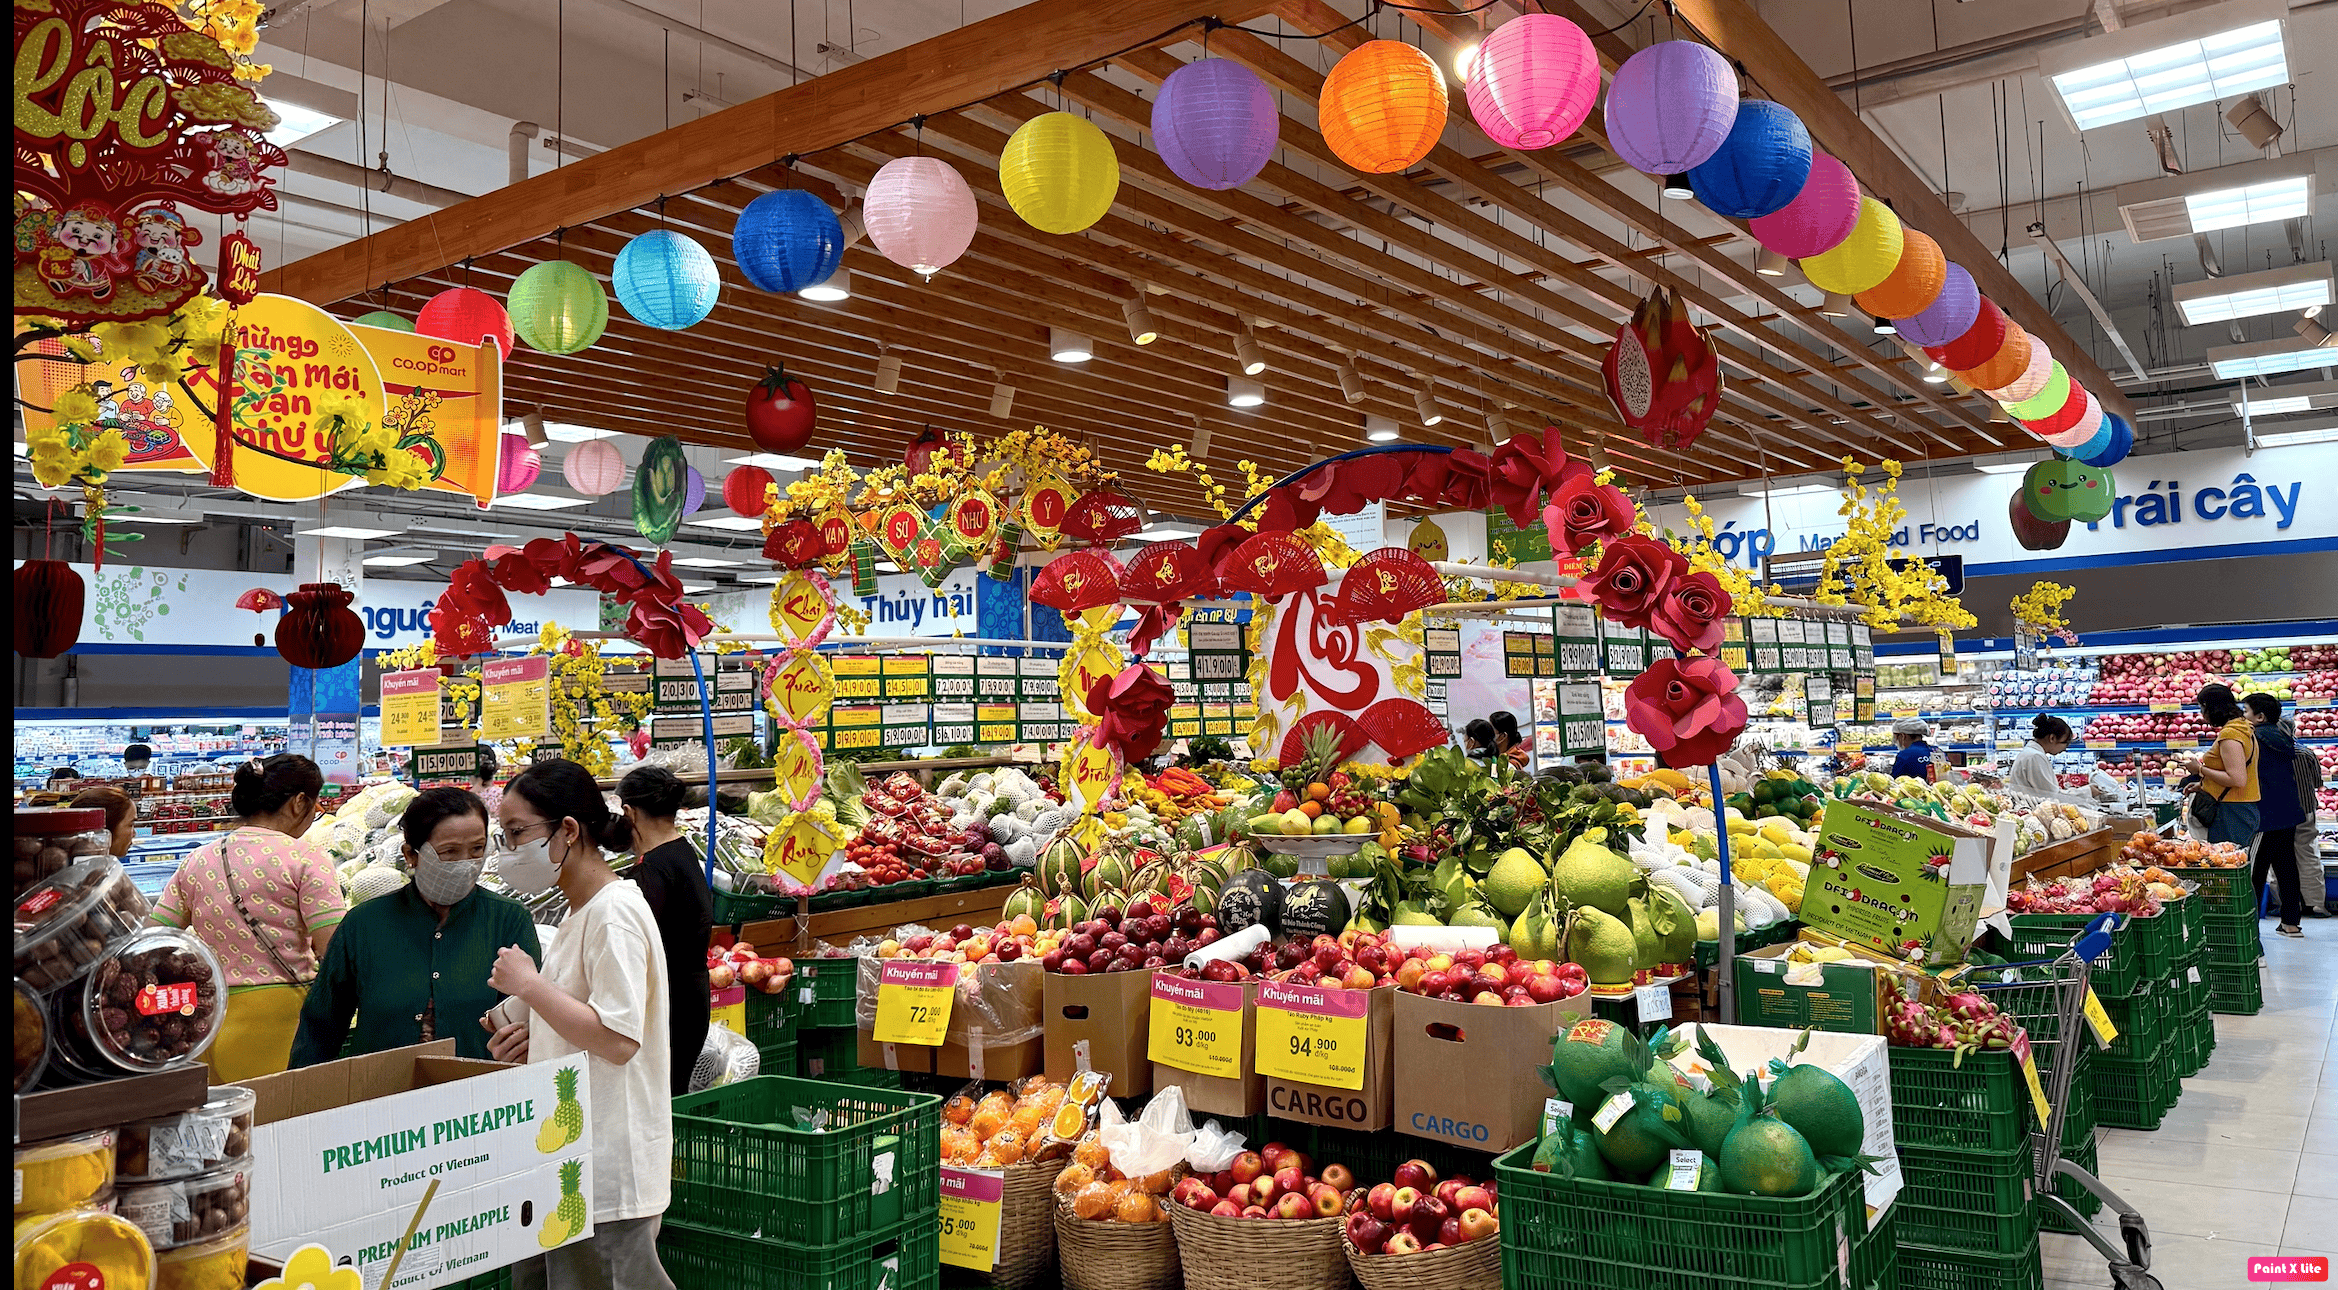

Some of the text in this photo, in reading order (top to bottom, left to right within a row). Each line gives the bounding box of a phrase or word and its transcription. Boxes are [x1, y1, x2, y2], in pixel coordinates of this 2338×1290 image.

[14, 17, 169, 168] Lộc
[231, 241, 260, 270] Phát
[229, 269, 257, 295] Lộc
[1044, 496, 1053, 519] Ý
[2087, 473, 2302, 531] rái cây
[895, 517, 910, 542] SỰ
[961, 508, 984, 530] NHƯ
[824, 527, 845, 548] VẠN
[1920, 519, 1979, 545] Food
[784, 593, 821, 623] Khai
[861, 583, 973, 628] Thủy hải
[502, 619, 539, 634] Meat
[1197, 659, 1232, 673] 41.900
[420, 755, 465, 770] 15.900
[1806, 911, 1835, 926] PRODUCT
[1845, 925, 1872, 939] VIETNAM
[887, 967, 938, 980] Khuyến mãi
[1155, 979, 1204, 999] Khuyến mãi
[1263, 987, 1324, 1006] Khuyến mãi
[1296, 1012, 1309, 1020] Ruby
[1271, 1086, 1368, 1122] CARGO
[1550, 1106, 1568, 1115] Select
[323, 1099, 535, 1174] PREMIUM PINEAPPLE
[1412, 1112, 1490, 1142] CARGO
[380, 1153, 490, 1189] Product Of Vietnam
[1676, 1156, 1697, 1164] Select
[946, 1178, 966, 1190] mãi
[358, 1204, 510, 1266] PREMUM PINEAPPLE
[445, 1251, 489, 1271] Vietnam
